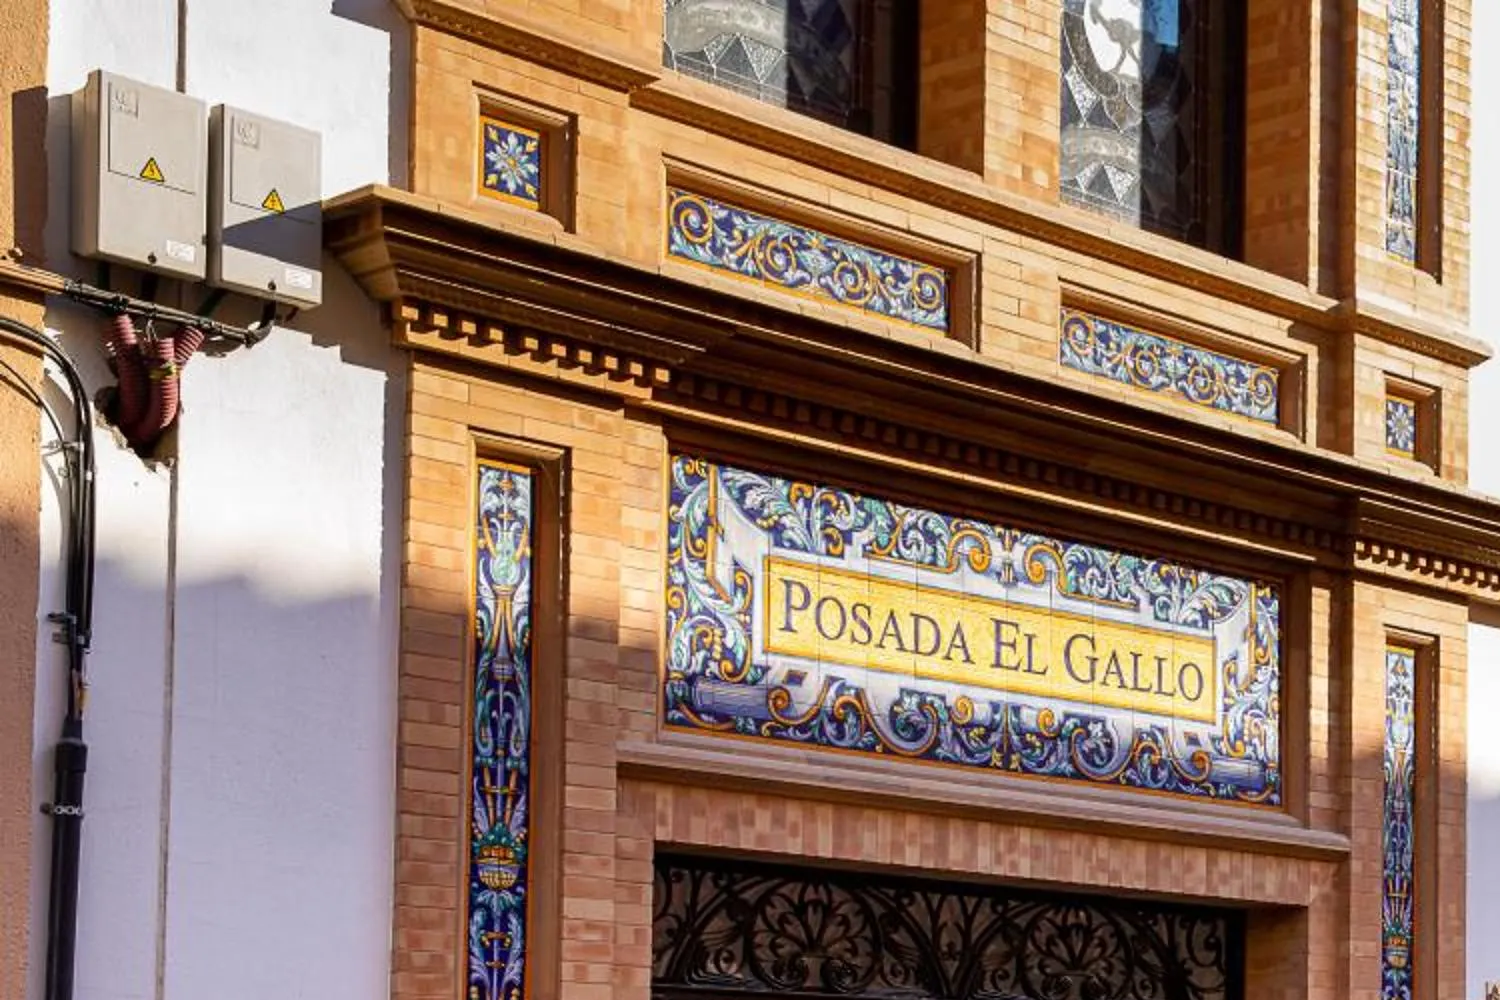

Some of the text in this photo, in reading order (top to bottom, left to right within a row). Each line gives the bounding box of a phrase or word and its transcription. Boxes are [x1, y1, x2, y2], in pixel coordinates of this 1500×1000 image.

[778, 578, 1205, 701] POSADA EL GALLO
